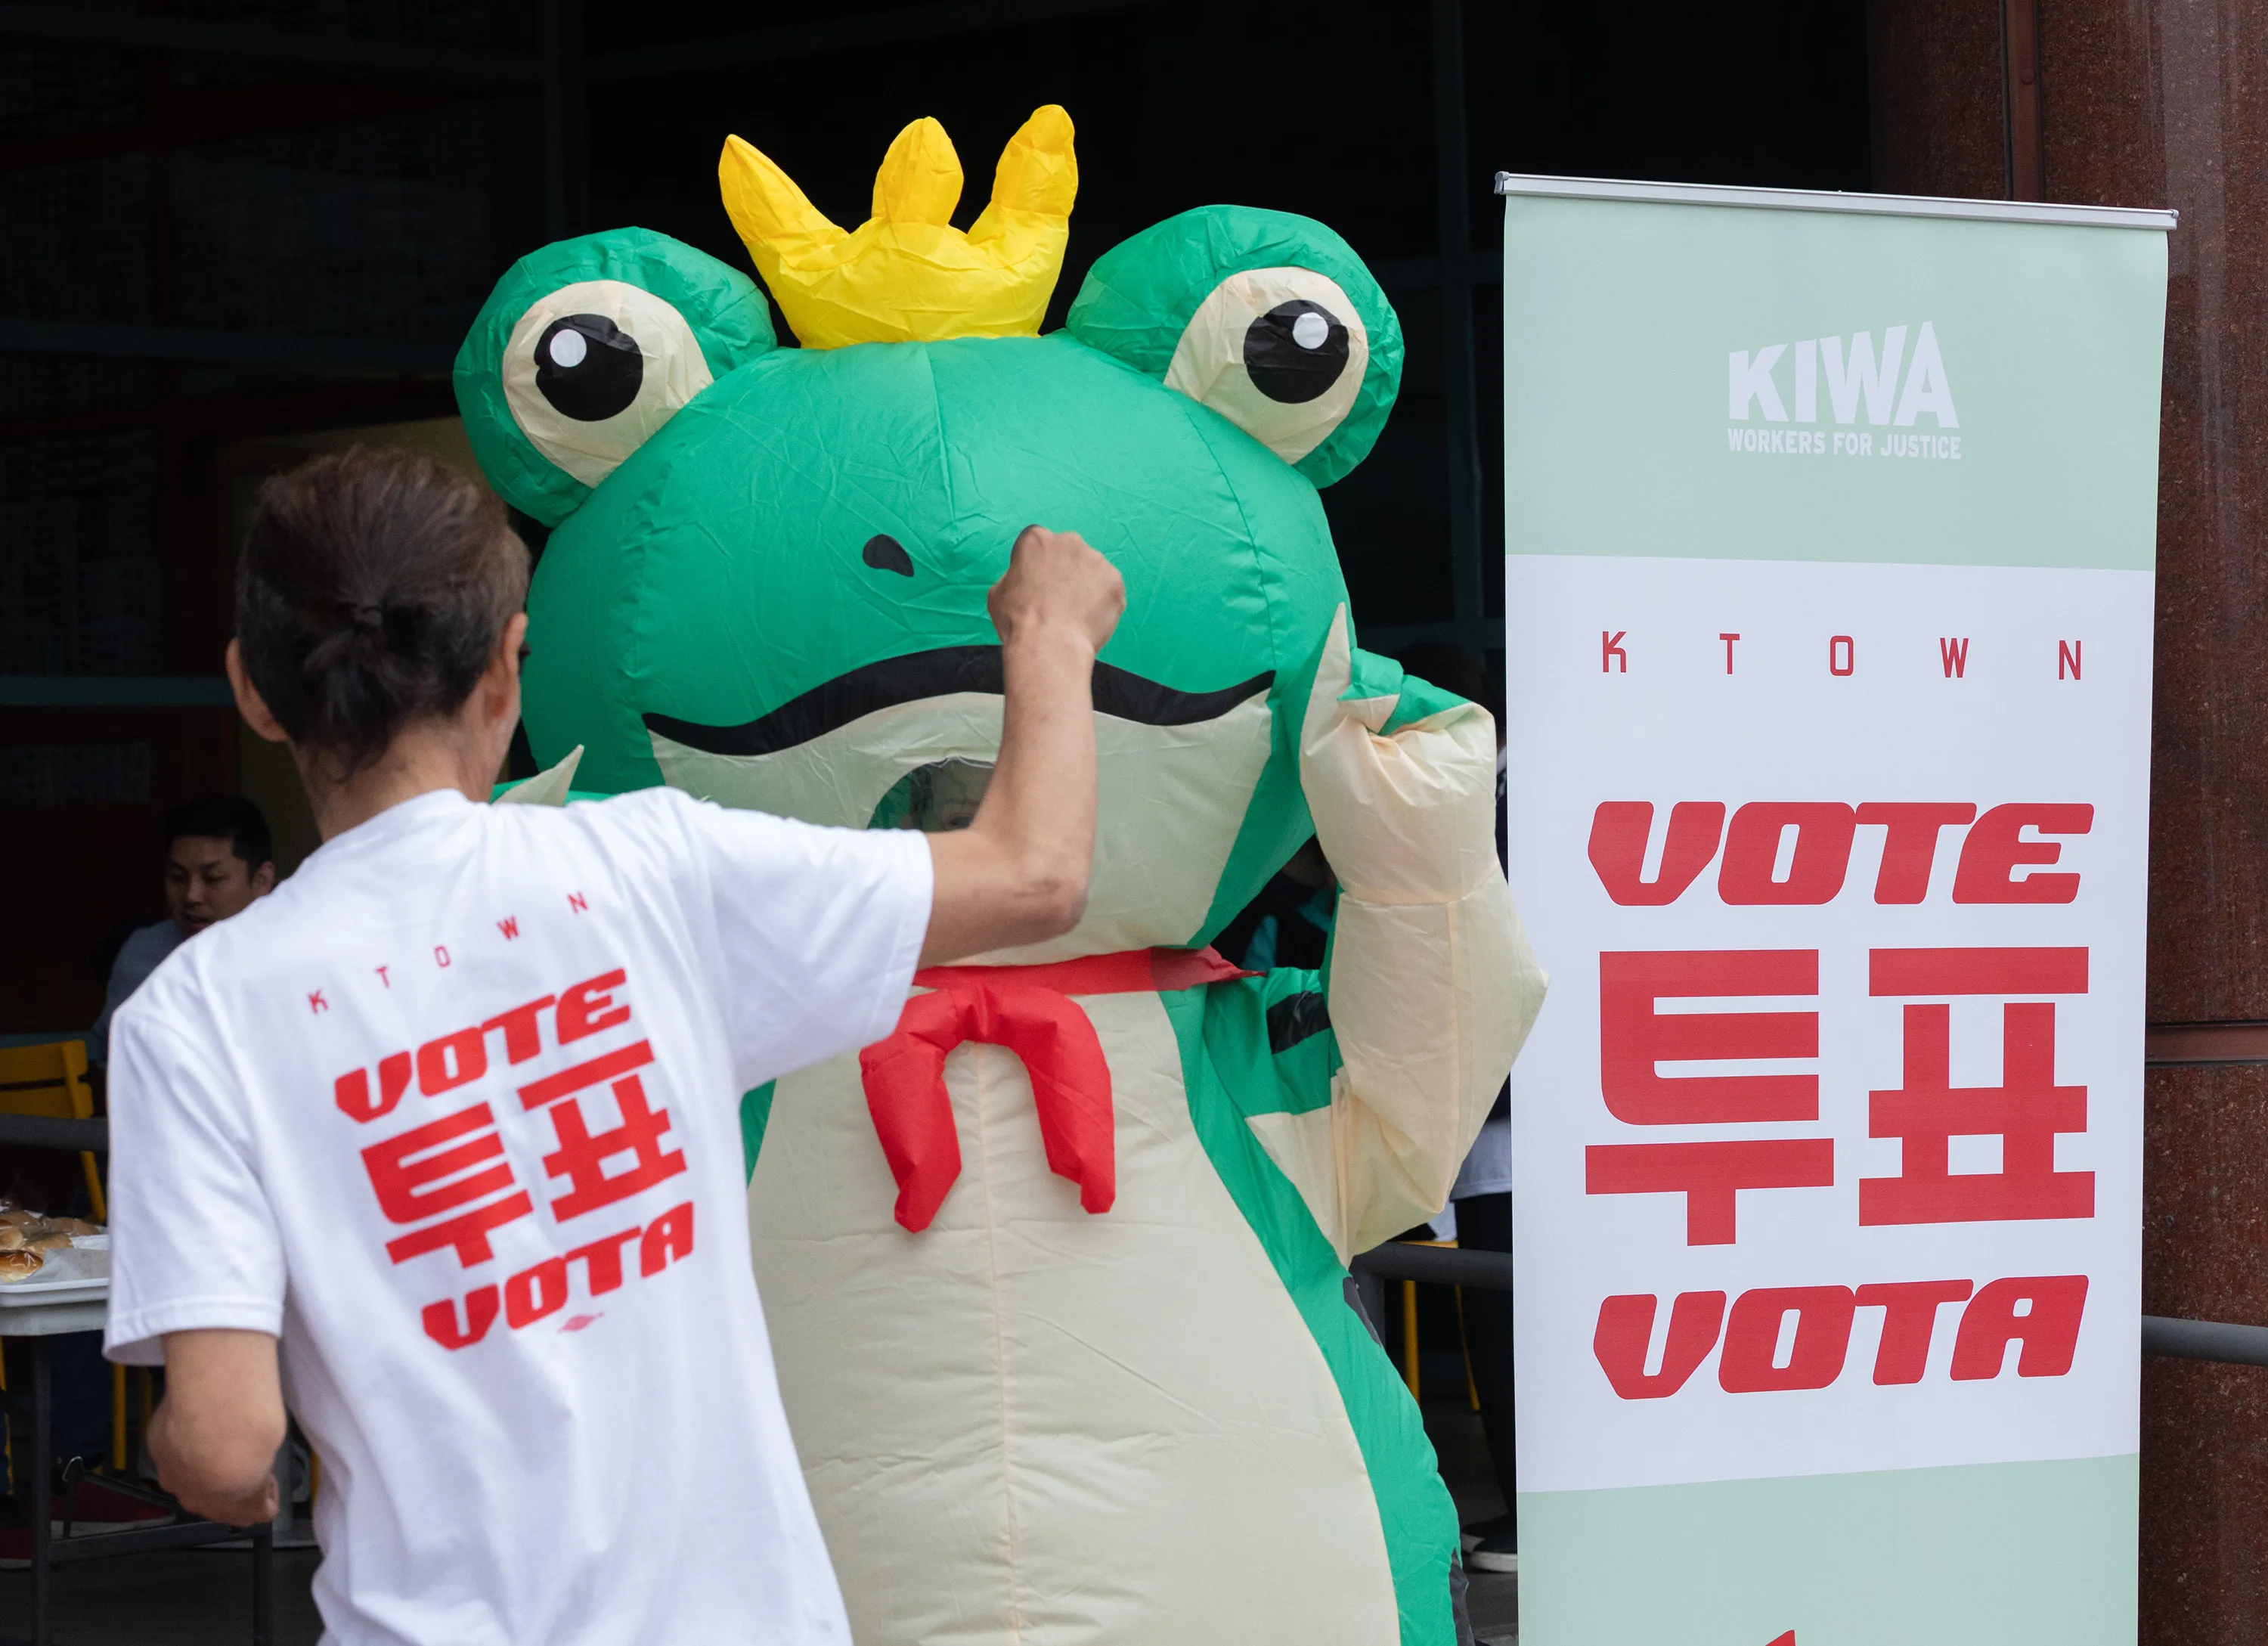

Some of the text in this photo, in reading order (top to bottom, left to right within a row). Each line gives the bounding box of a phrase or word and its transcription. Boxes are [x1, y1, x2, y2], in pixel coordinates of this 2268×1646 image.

[1728, 321, 1960, 429] KIWA
[1728, 429, 1962, 460] WORKERS FOR JUSTICE
[1588, 801, 2094, 906] VOTE
[334, 967, 631, 1124] VOTE
[1585, 947, 2096, 1246] 투표
[359, 1038, 688, 1269] 투표
[420, 1200, 695, 1351] VOTA
[1594, 1275, 2089, 1400] VOTA
